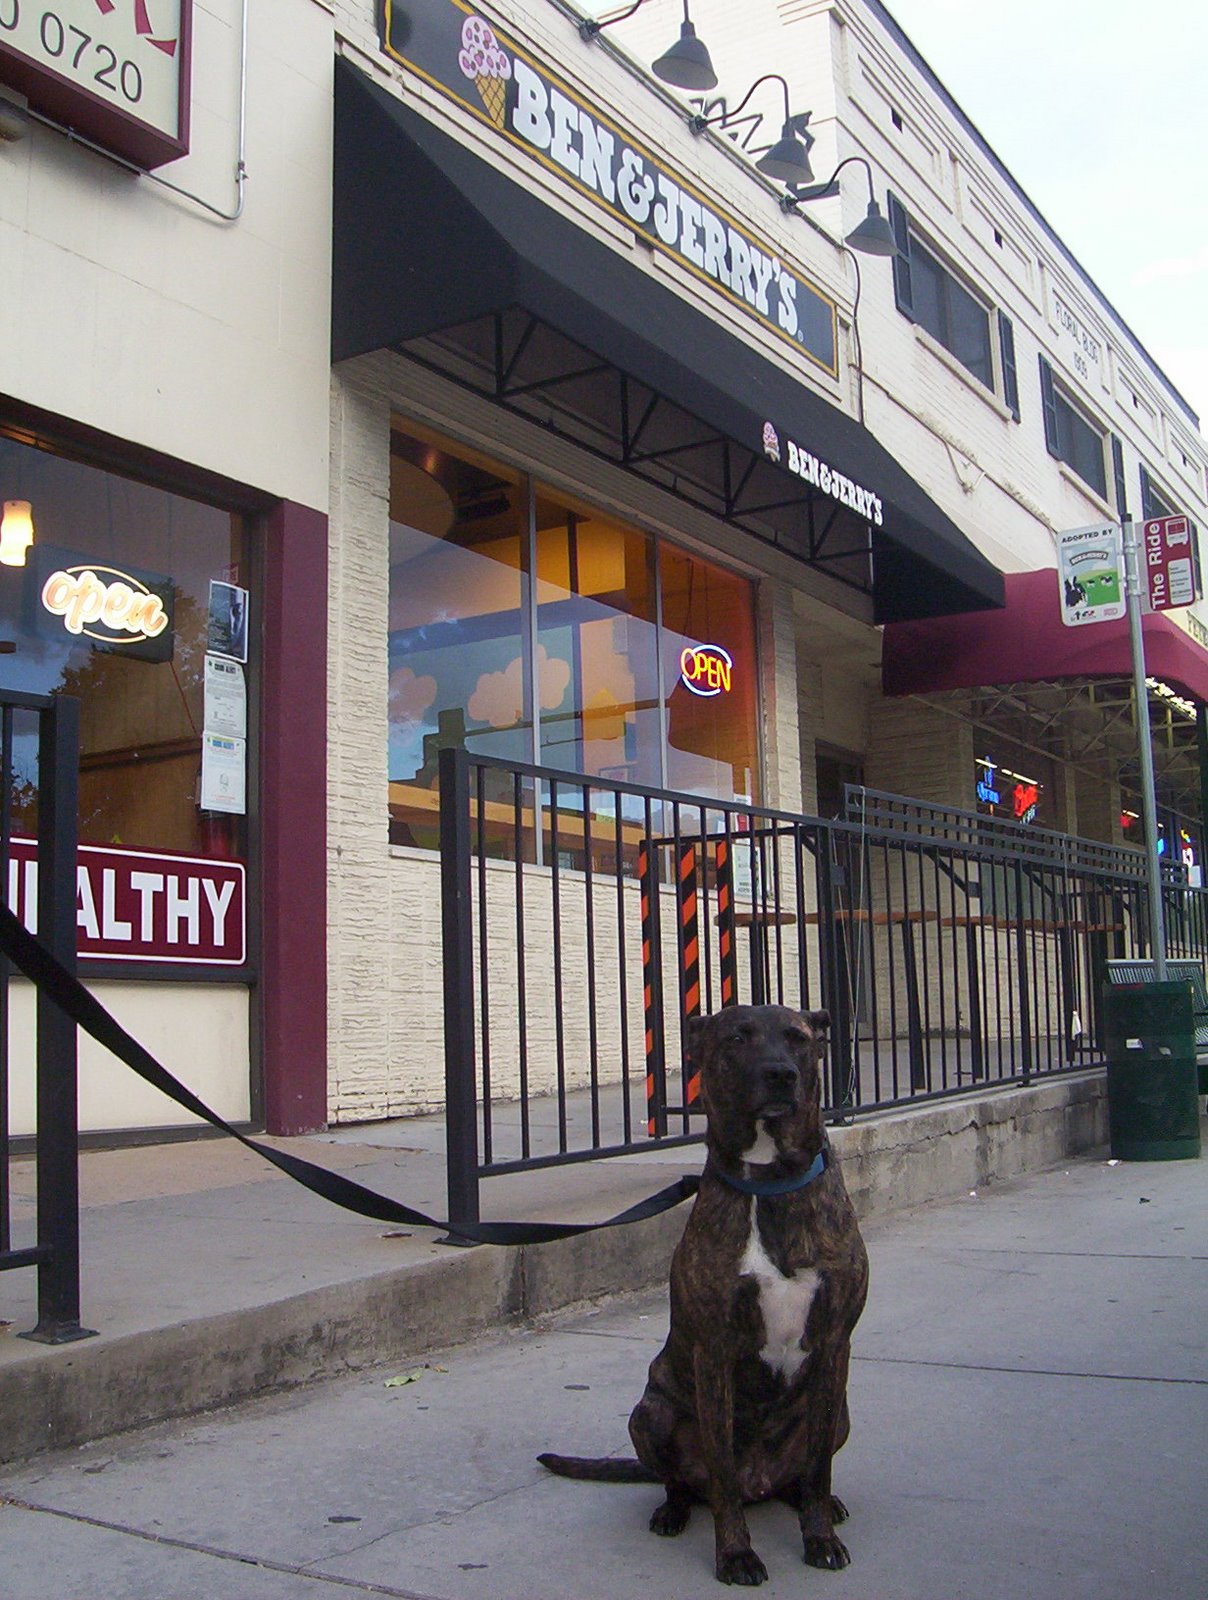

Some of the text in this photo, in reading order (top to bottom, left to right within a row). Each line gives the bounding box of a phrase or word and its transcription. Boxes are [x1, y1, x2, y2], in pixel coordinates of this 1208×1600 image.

[40, 11, 143, 103] 0720
[1061, 528, 1113, 544] ADOPTED BY
[1147, 522, 1166, 609] The Ride
[42, 571, 169, 637] open
[681, 648, 731, 692] OPEN
[8, 858, 236, 946] ALTHY
